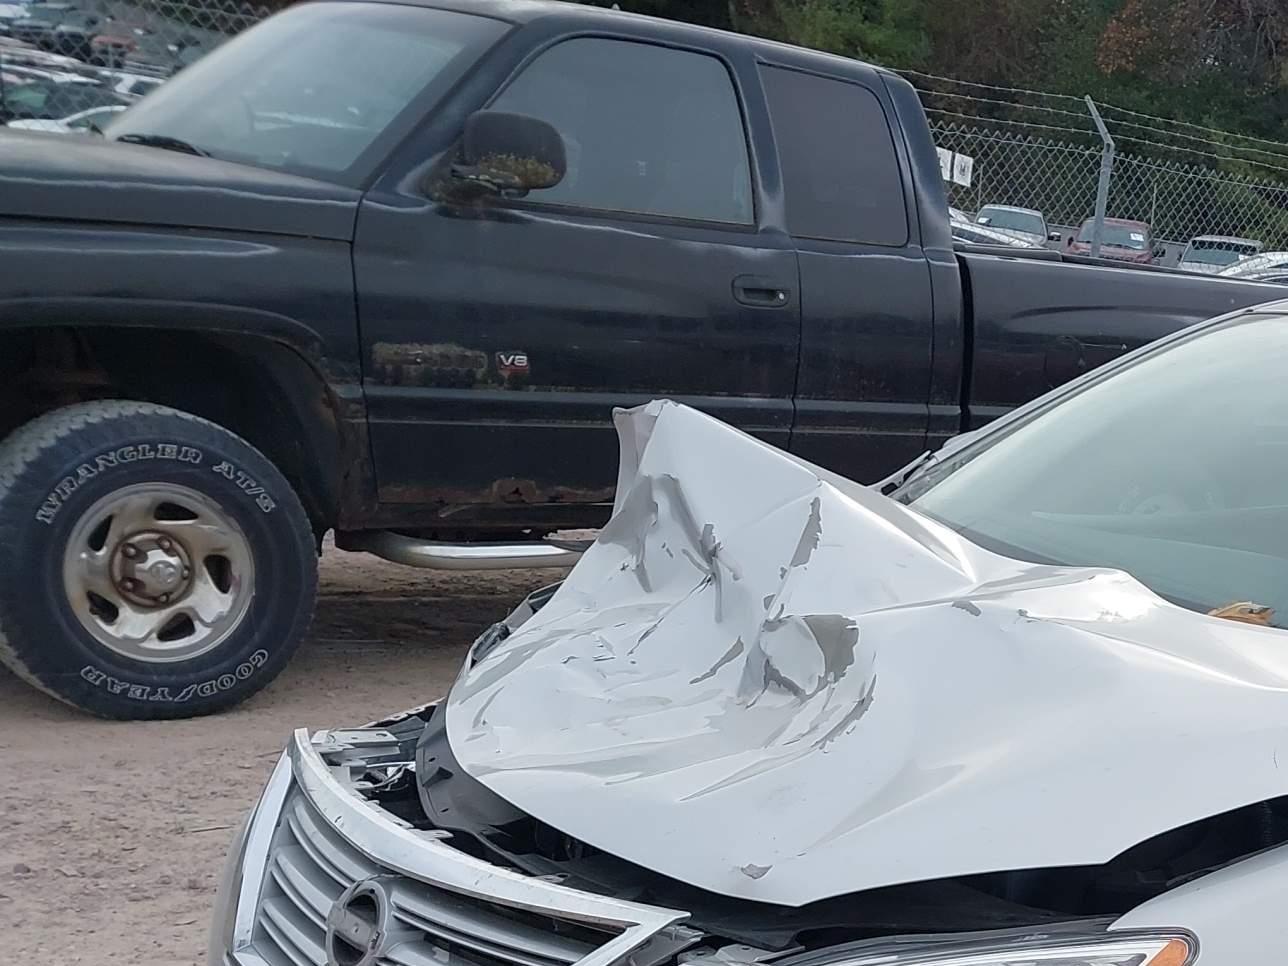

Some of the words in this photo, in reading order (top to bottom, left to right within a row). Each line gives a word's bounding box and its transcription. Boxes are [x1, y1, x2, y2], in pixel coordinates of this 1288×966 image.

[500, 354, 528, 366] V8
[36, 444, 202, 525] WRANGLER
[212, 460, 276, 513] AT/S
[80, 649, 269, 702] GOODYEAR
